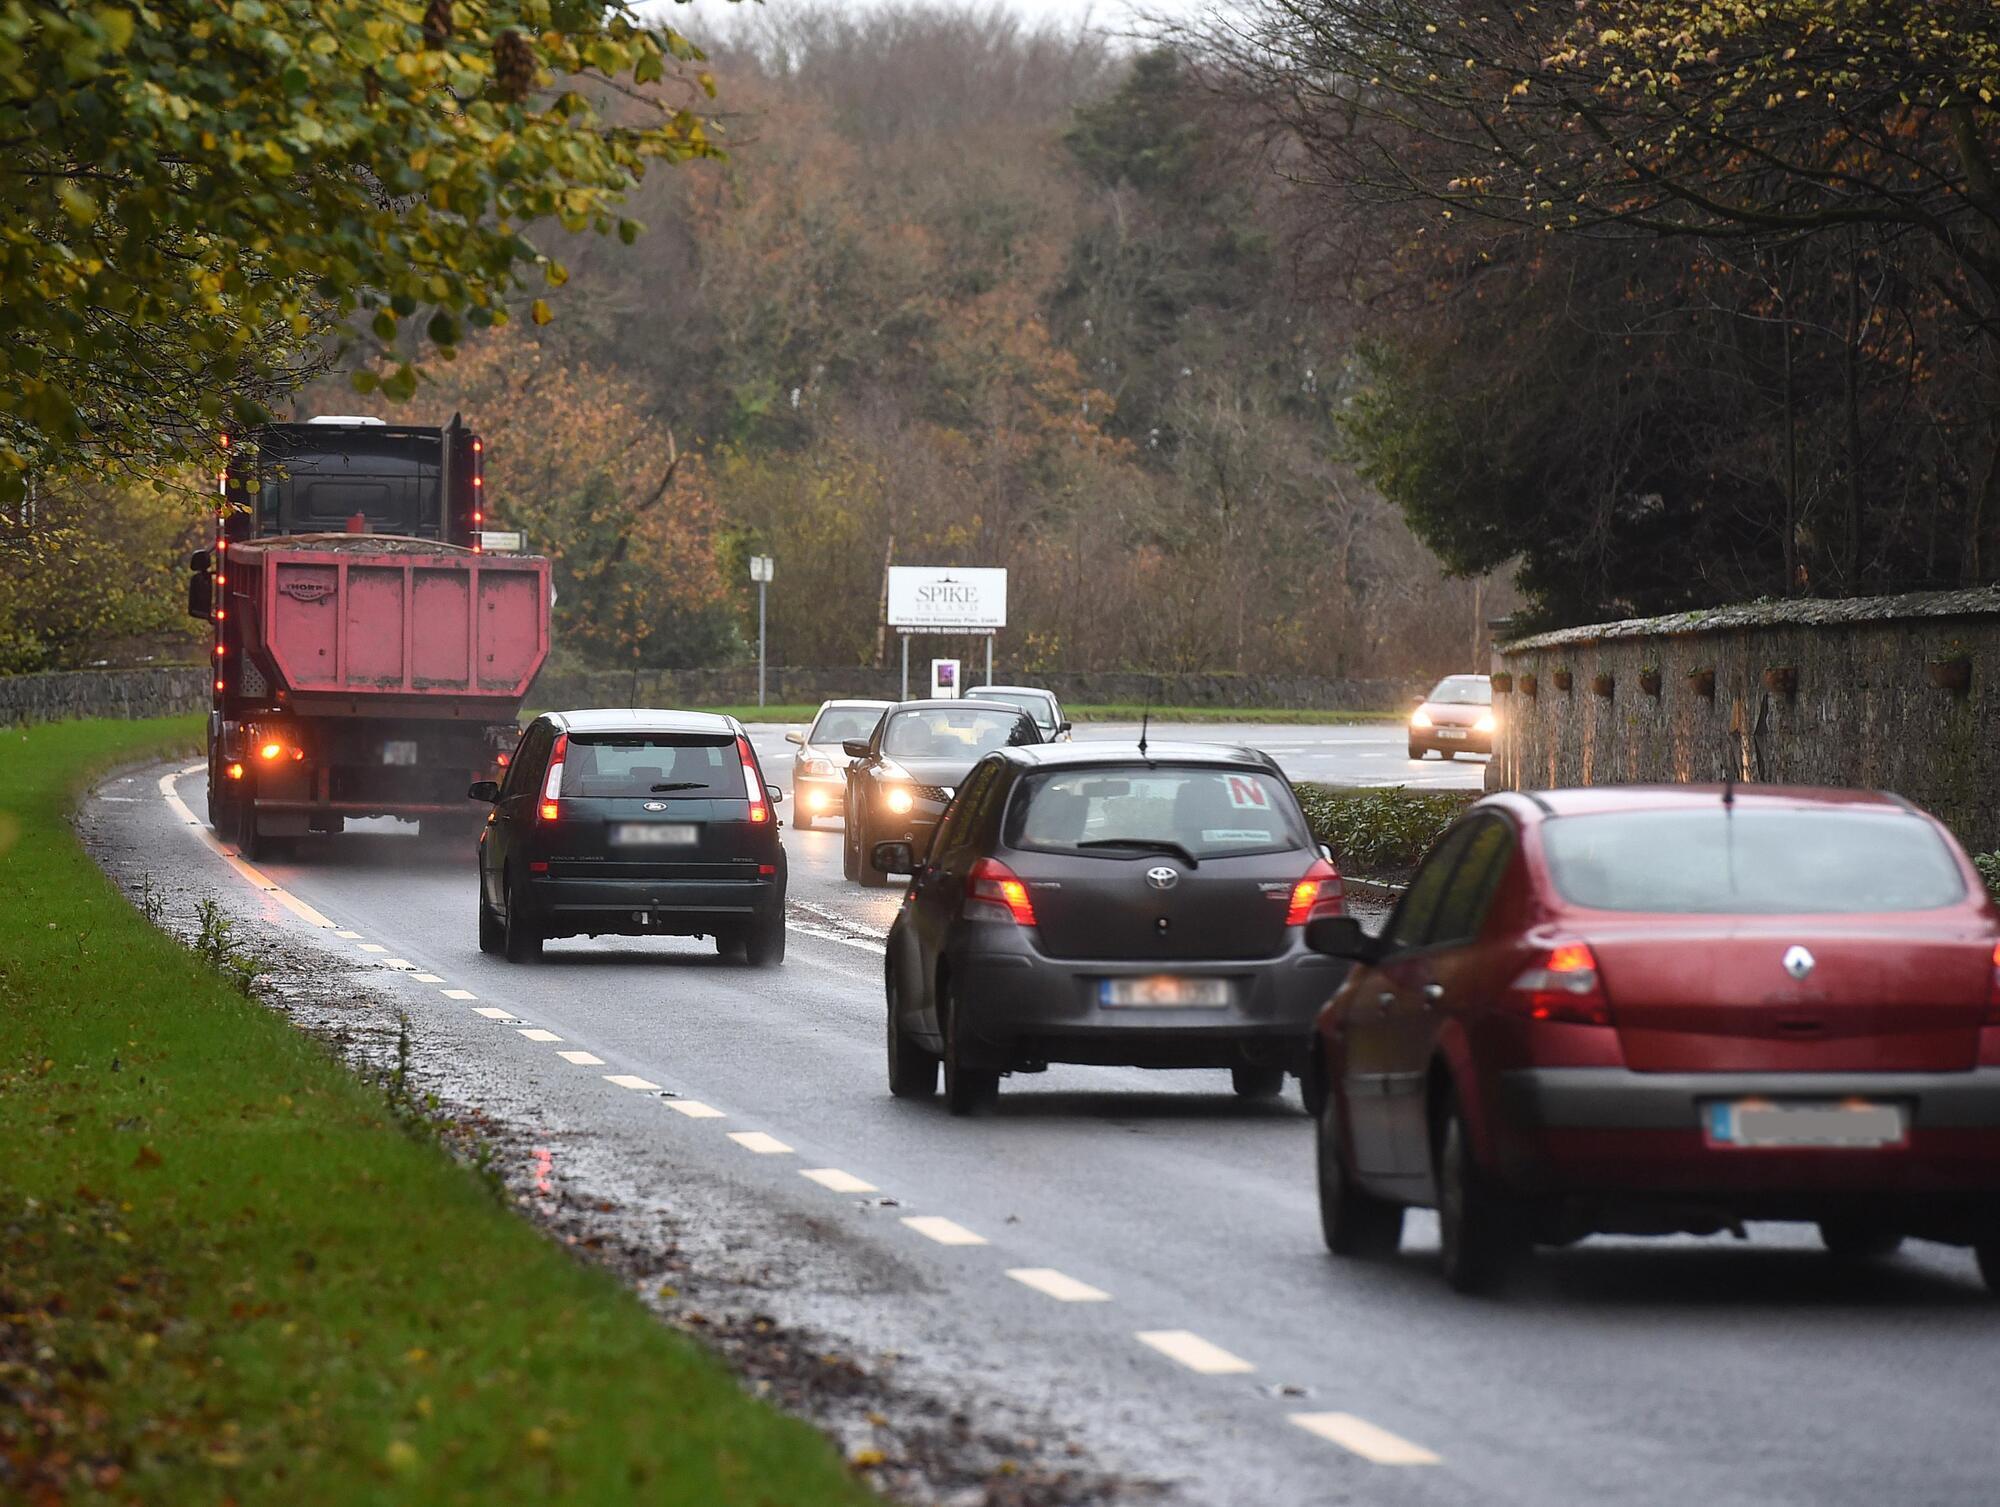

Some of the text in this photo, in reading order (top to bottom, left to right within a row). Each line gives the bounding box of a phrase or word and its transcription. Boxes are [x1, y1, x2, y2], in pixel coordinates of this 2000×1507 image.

[914, 585, 979, 603] SPIKE
[916, 603, 979, 611] ISLAND
[1230, 777, 1265, 806] N
